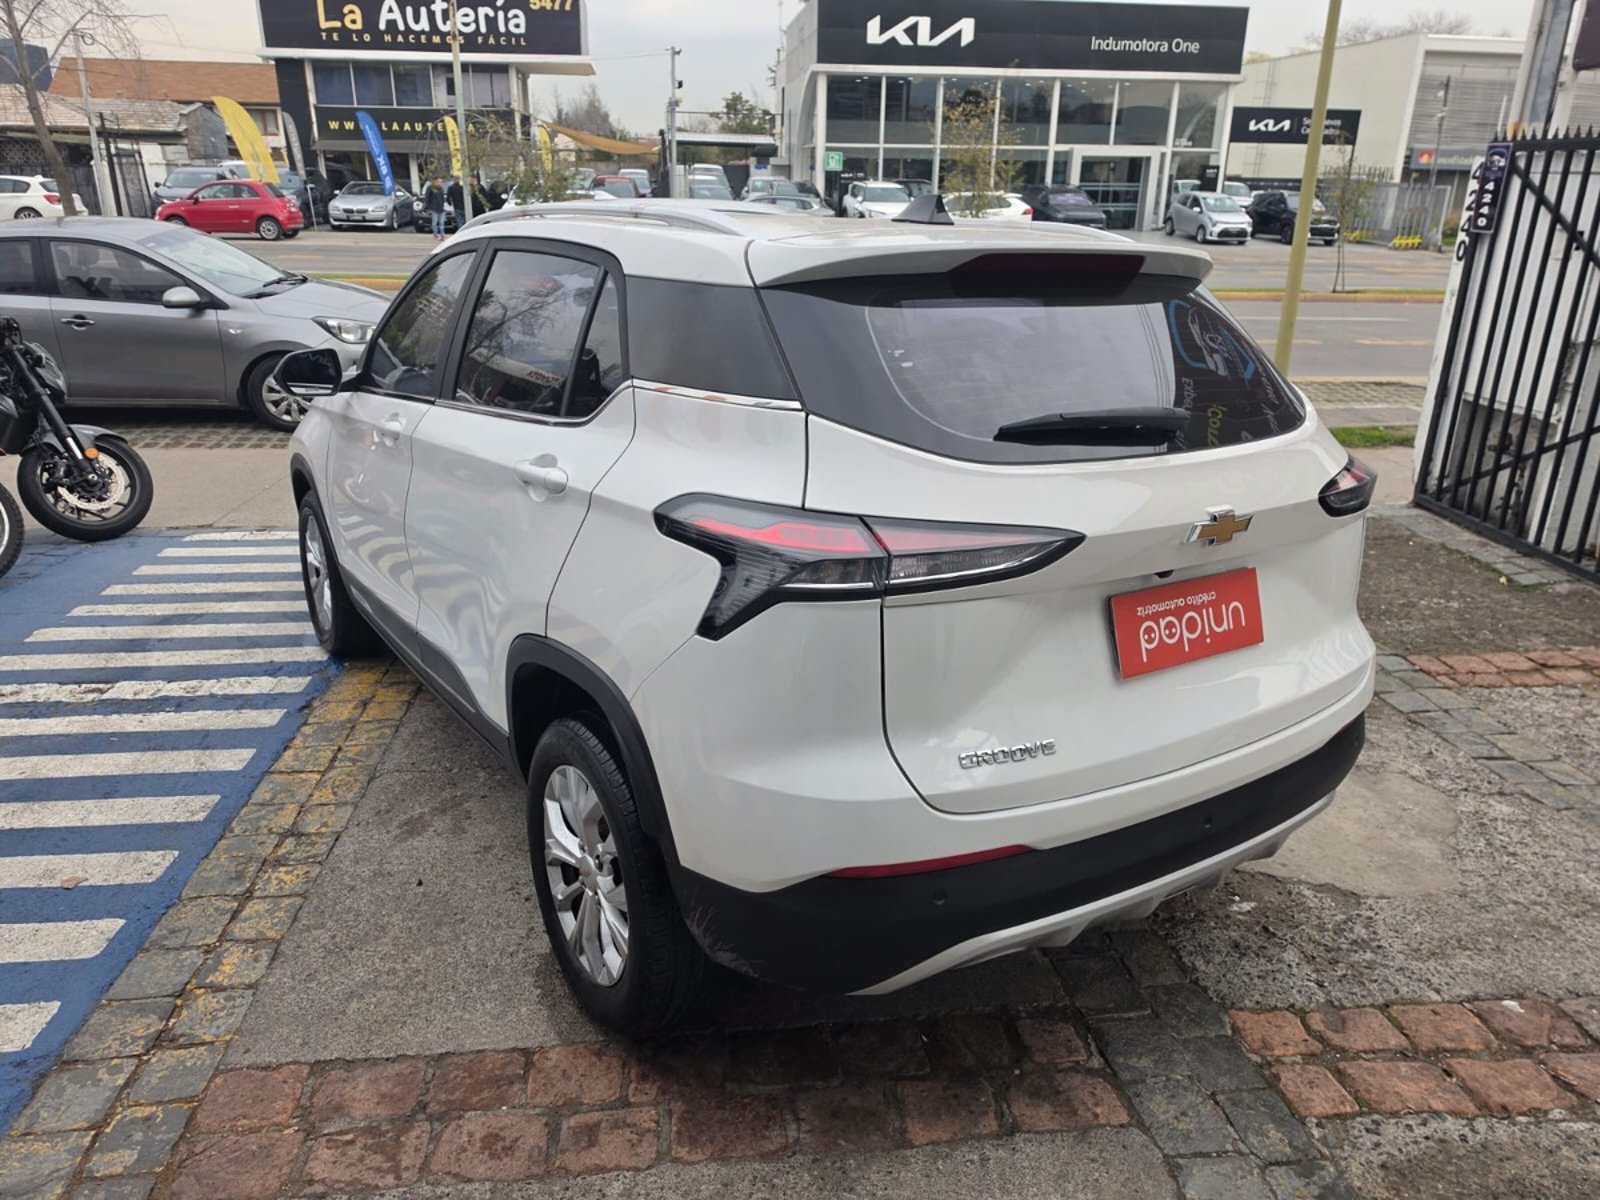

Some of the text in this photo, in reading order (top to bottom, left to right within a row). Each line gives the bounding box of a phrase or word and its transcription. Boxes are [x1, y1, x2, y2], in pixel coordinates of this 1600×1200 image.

[316, 0, 526, 34] La Autería
[320, 32, 527, 46] TE LO HACEMOS FÁCIL
[1091, 36, 1200, 53] Indumotora One
[1477, 181, 1496, 227] 4240
[1137, 591, 1216, 617] crédito automotriz
[1139, 601, 1246, 663] unidad
[958, 738, 1057, 770] GROOVE
